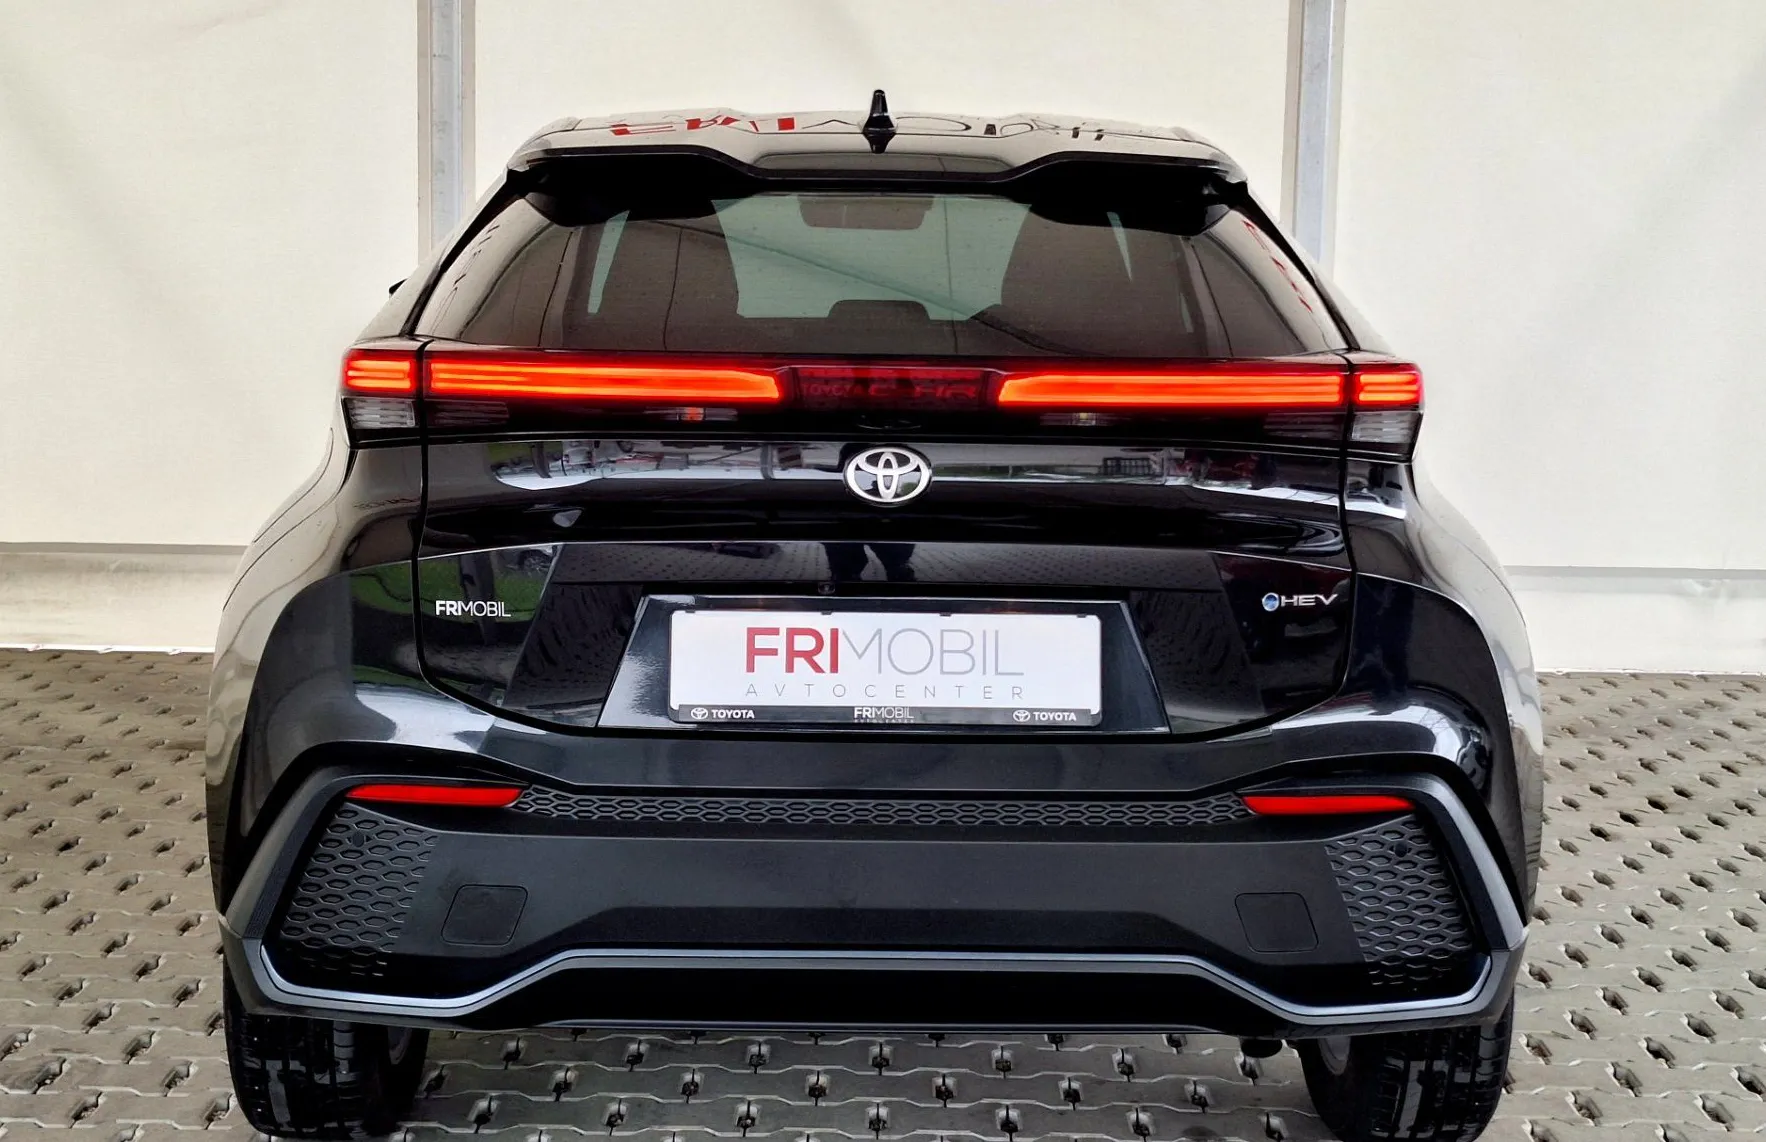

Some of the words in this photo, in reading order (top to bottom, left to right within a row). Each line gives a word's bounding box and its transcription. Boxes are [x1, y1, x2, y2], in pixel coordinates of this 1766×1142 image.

[1280, 593, 1338, 607] HEV
[435, 600, 512, 617] FRIMOBIL
[745, 626, 1024, 676] FRIMOBIL
[745, 683, 1023, 700] AVTOCENTER
[711, 708, 755, 719] TOYOTA
[854, 706, 915, 719] FRIMOBIL
[1033, 711, 1077, 722] TOYOTA
